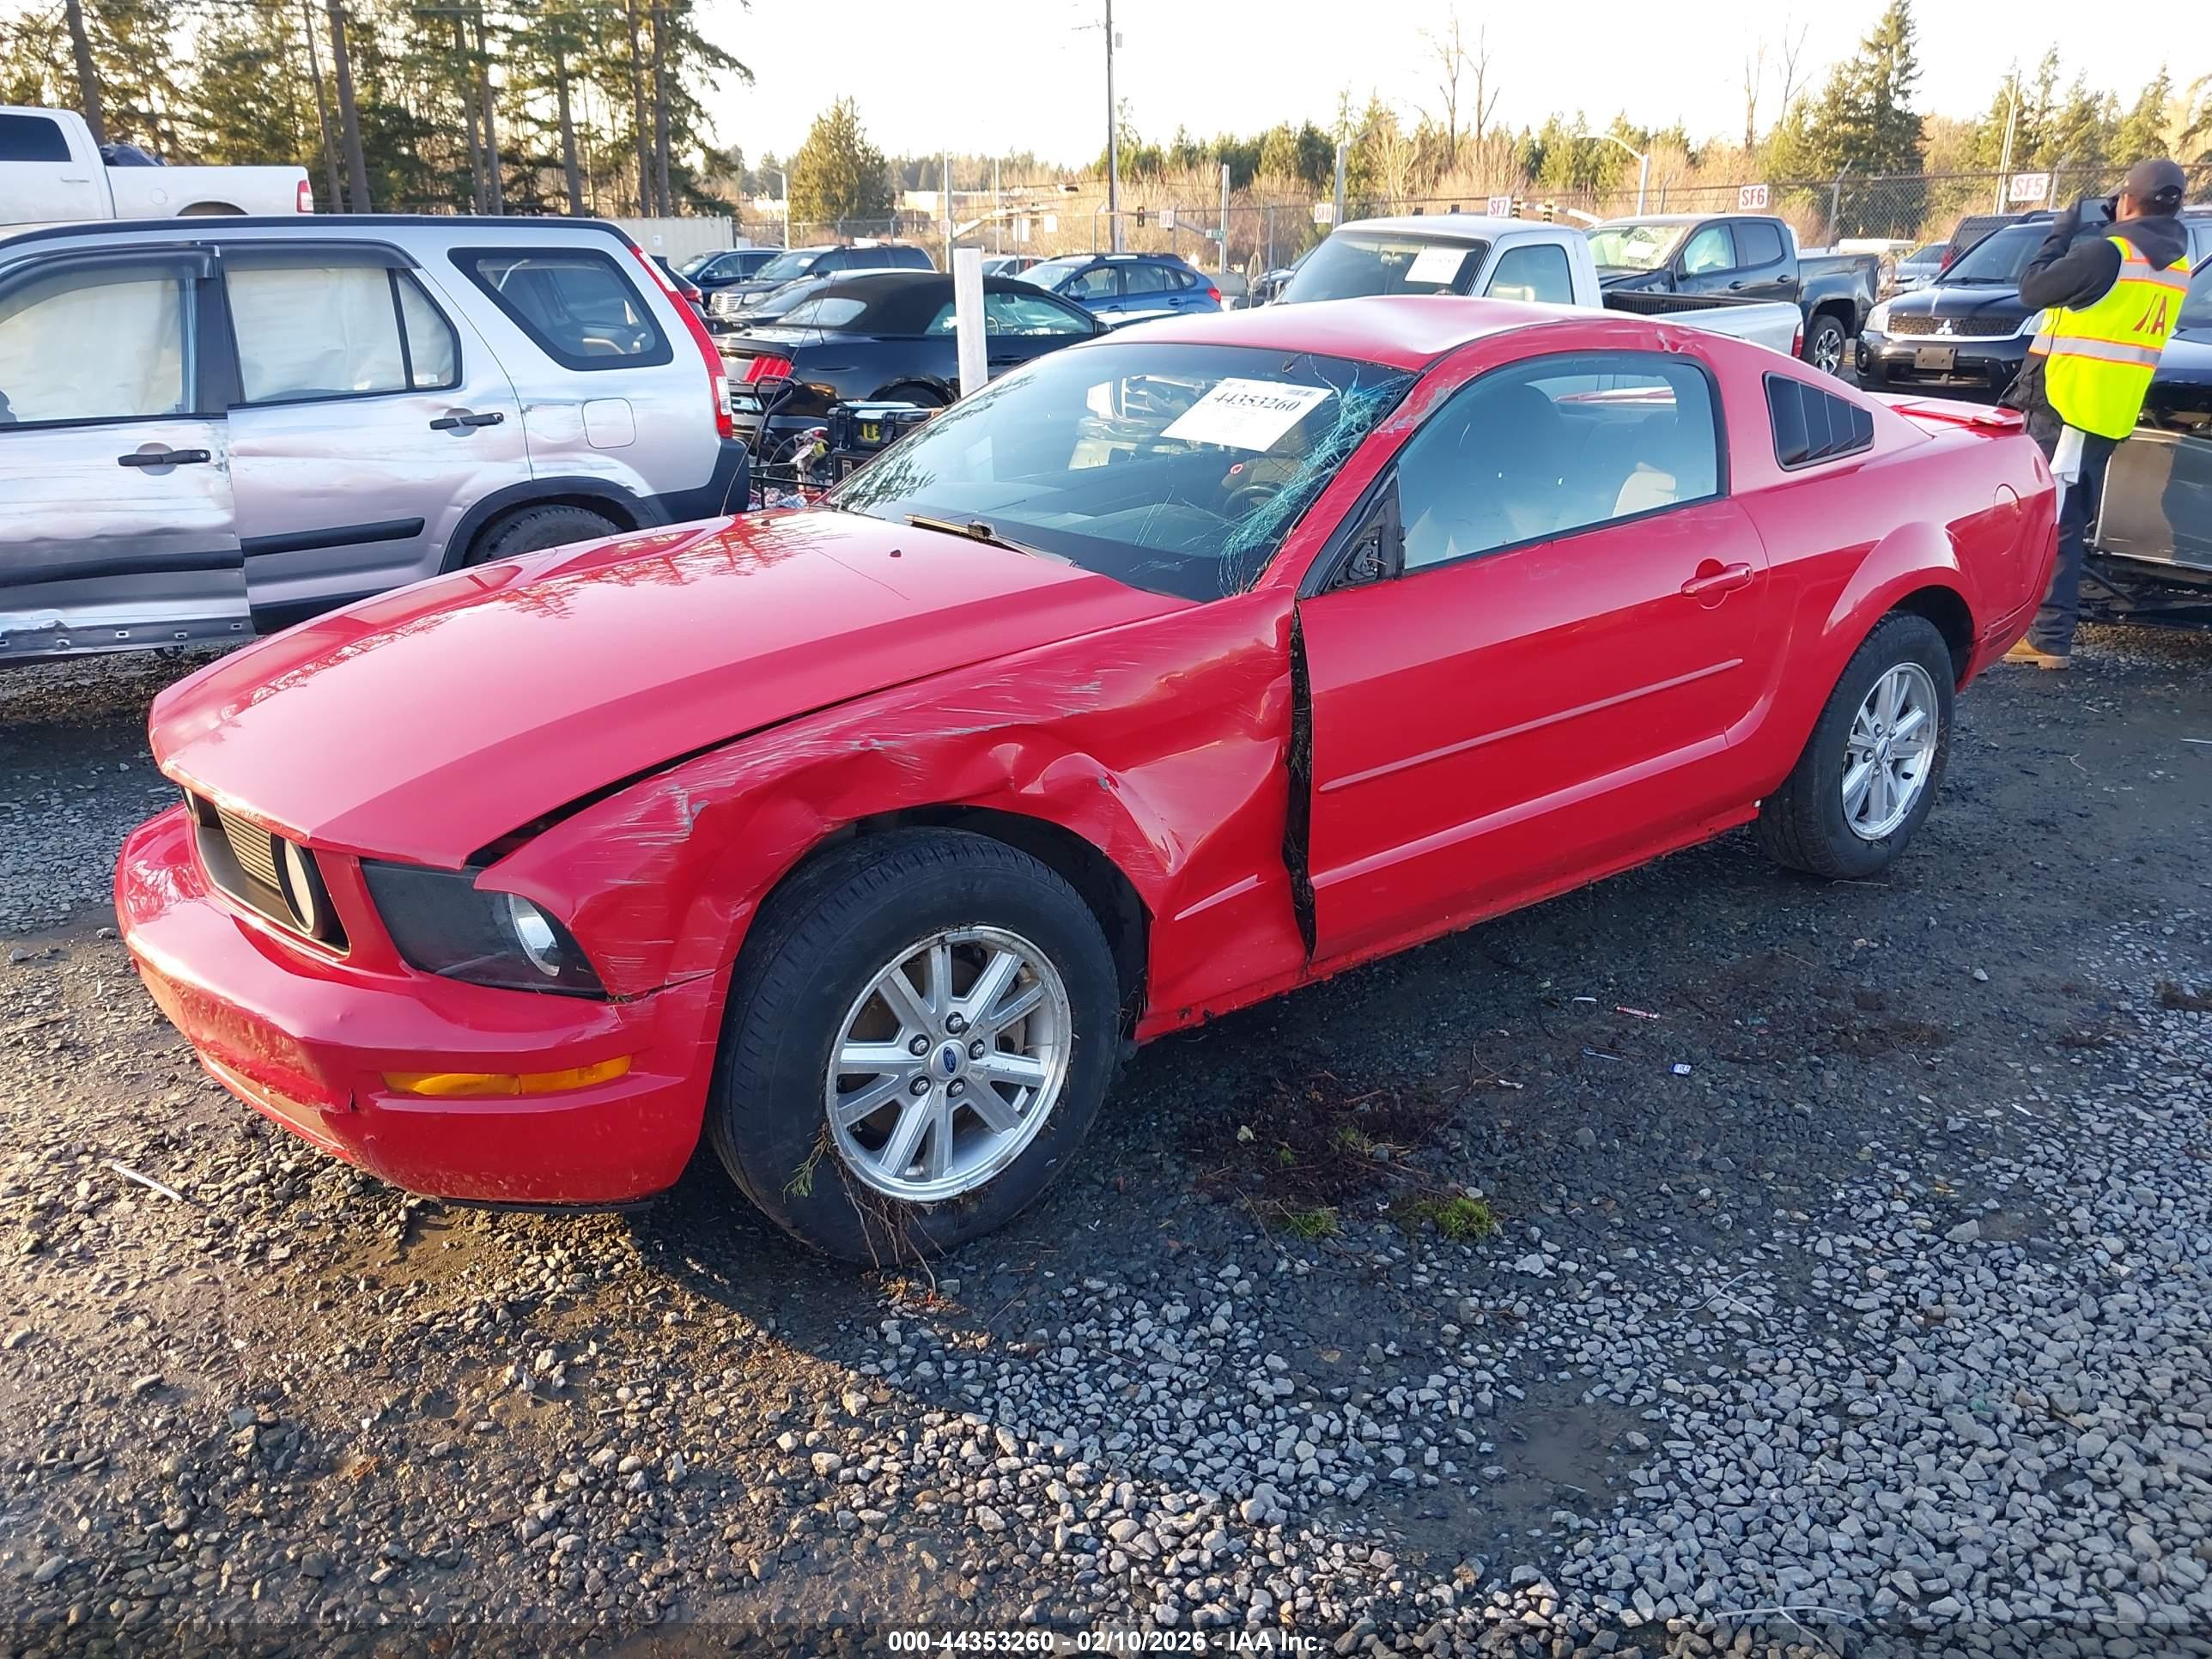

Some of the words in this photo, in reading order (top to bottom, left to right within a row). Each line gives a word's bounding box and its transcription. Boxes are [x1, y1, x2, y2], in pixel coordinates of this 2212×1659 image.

[1742, 187, 1765, 206] SF6
[2014, 177, 2045, 198] SF5
[1491, 198, 1507, 215] SF7
[1213, 392, 1302, 412] 44353260
